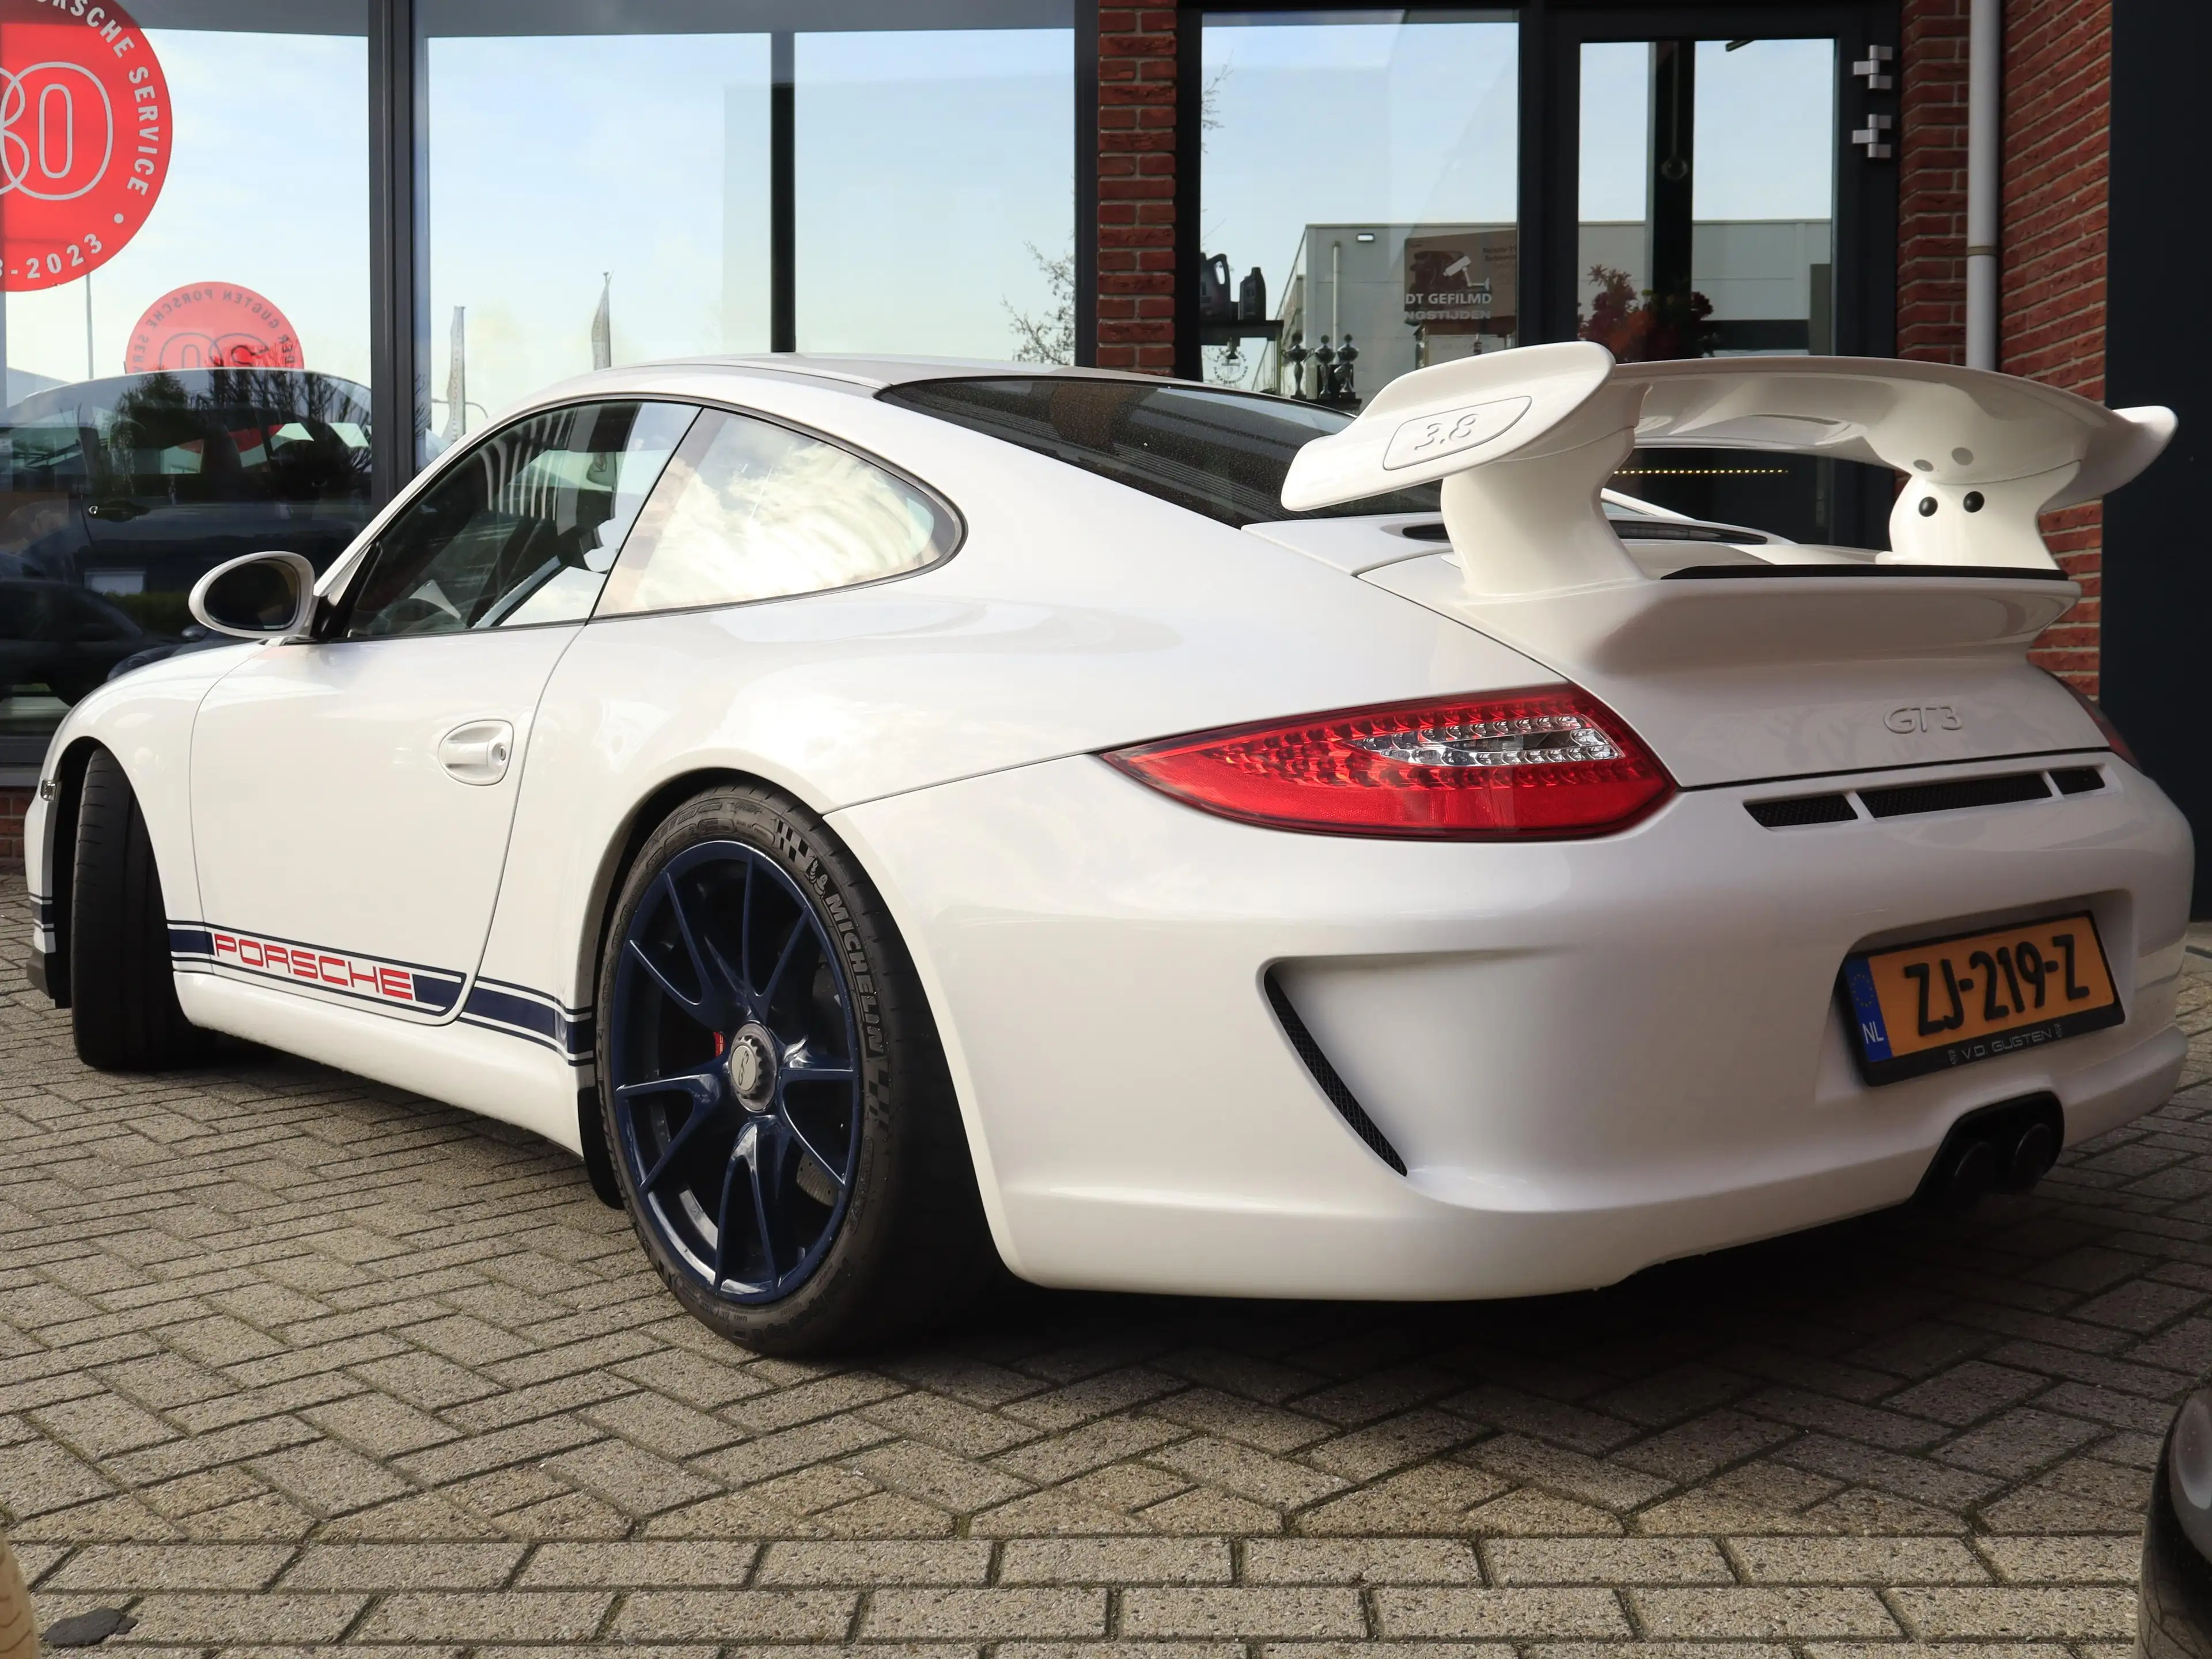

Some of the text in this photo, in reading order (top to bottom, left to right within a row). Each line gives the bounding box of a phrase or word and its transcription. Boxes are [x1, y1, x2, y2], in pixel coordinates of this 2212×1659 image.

[127, 66, 160, 196] SERVICE
[1405, 310, 1491, 320] NGSTIJDEN
[1427, 293, 1493, 305] GEFILMD
[1414, 413, 1480, 450] 3.8
[1883, 705, 1963, 734] GT3
[214, 933, 413, 1001] PORSCHE
[825, 893, 884, 1054] MICHELIN
[1904, 934, 2090, 1036] ZJ-219-Z
[1862, 1021, 1884, 1044] NL
[1992, 1028, 2053, 1053] GUGTEN
[738, 1050, 749, 1086] GT3
